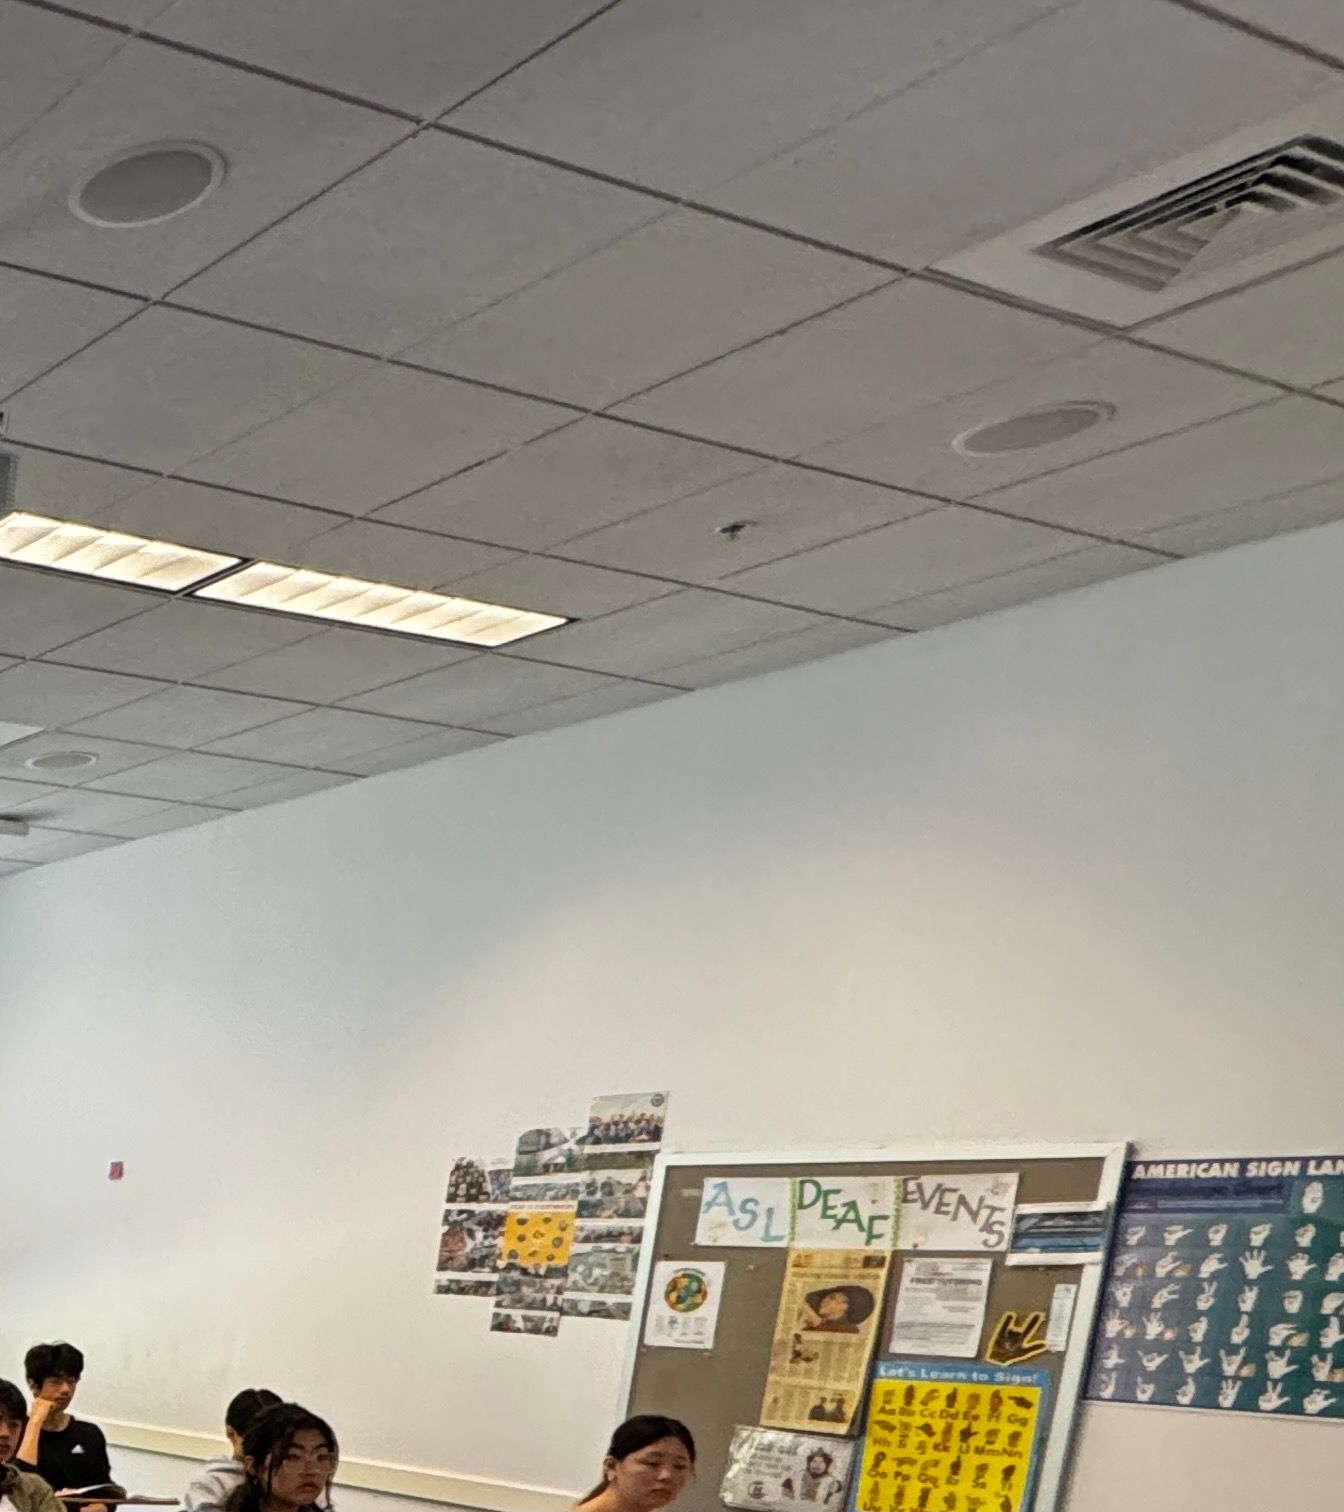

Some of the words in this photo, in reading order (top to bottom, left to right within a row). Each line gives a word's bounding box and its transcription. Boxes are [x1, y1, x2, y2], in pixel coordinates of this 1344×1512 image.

[1132, 1161, 1239, 1179] AMERICAN
[1245, 1160, 1301, 1176] SIGN
[703, 1181, 786, 1243] ASL
[797, 1178, 890, 1246] DEAF
[898, 1176, 1006, 1249] EVENTS
[920, 1367, 967, 1380] Learn
[971, 1371, 989, 1382] to
